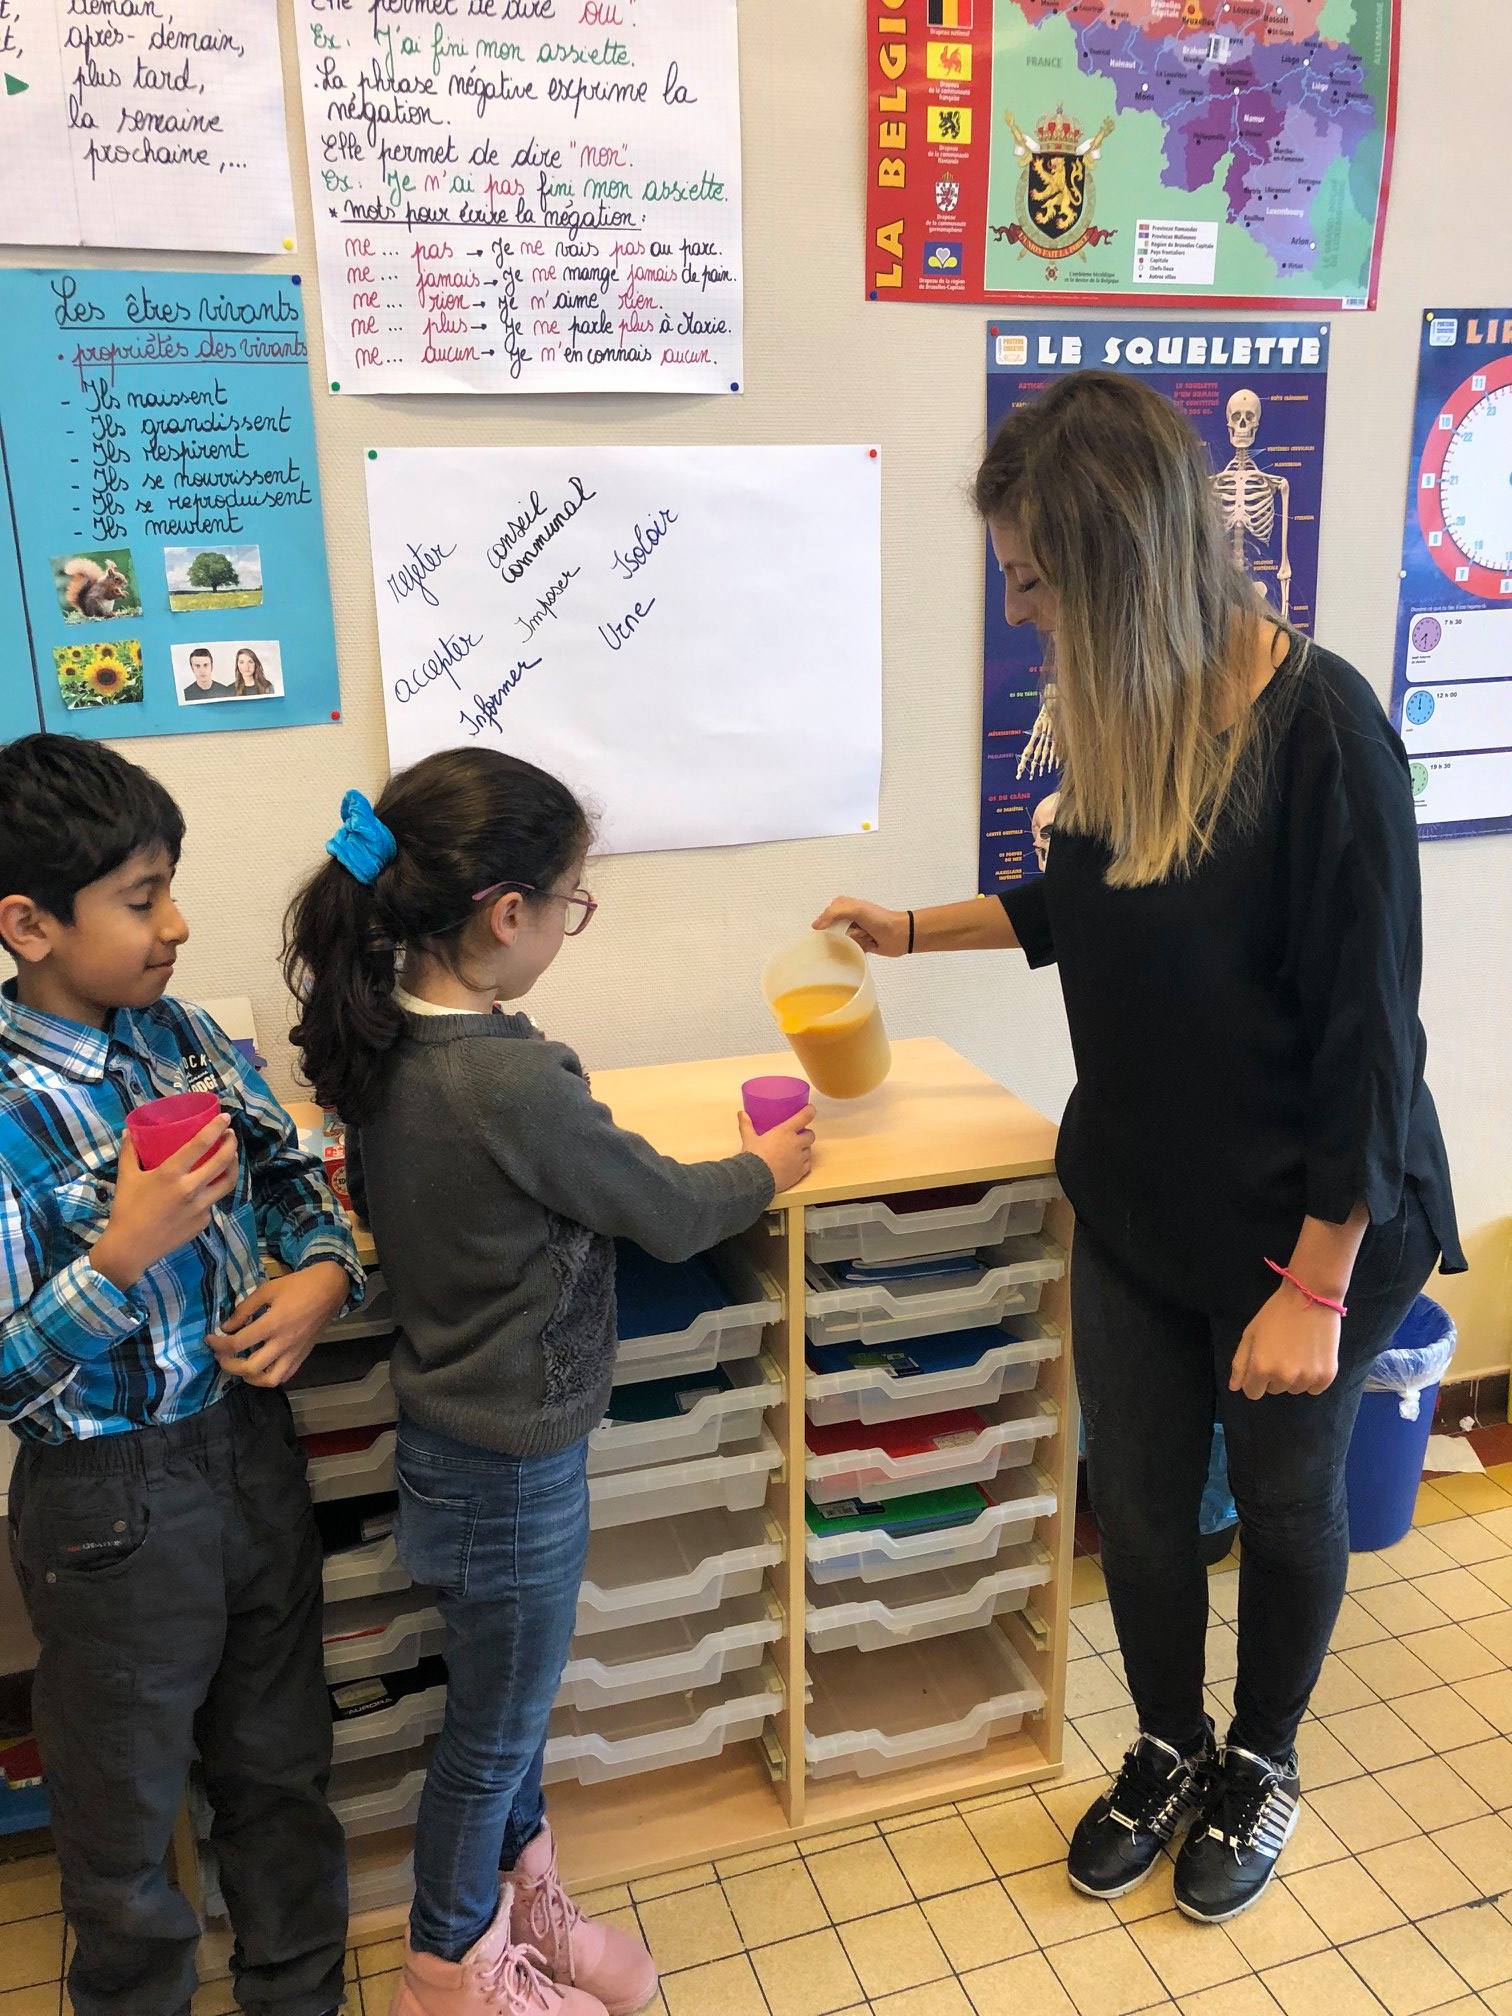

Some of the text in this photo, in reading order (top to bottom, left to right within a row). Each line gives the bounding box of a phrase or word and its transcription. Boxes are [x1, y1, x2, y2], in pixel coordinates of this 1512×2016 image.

[431, 22, 469, 76] fini
[476, 39, 526, 61] mon
[536, 38, 635, 67] assiette.
[1026, 56, 1063, 69] FRANCE
[73, 57, 205, 105] plus tard,
[358, 58, 438, 119] phrase
[449, 66, 538, 118] négative
[548, 77, 648, 119] exprime
[663, 61, 698, 105] la
[67, 95, 224, 133] la semaine
[328, 92, 451, 147] négation.
[321, 131, 365, 162] Elle
[378, 135, 459, 183] permet
[468, 138, 500, 166] de
[511, 136, 562, 168] dire
[388, 169, 416, 207] Je
[484, 174, 525, 212] pas
[537, 170, 575, 212] fini
[583, 178, 632, 200] mon
[642, 170, 728, 202] assiette.
[344, 195, 397, 220] mots
[406, 201, 451, 233] pour
[459, 200, 509, 225] écrire
[516, 197, 537, 224] la
[411, 241, 454, 274] pas
[492, 237, 515, 269] Je
[521, 239, 545, 256] ne
[555, 241, 600, 257] vais
[609, 240, 645, 269] pas
[650, 241, 674, 256] au
[679, 238, 722, 268] parc.
[876, 218, 905, 289] LA
[51, 275, 299, 326] Les êtres vivants
[416, 268, 480, 308] jamais
[502, 267, 525, 297] Je
[532, 266, 557, 282] ne
[563, 266, 619, 294] mange
[627, 264, 678, 297] jamais
[682, 262, 700, 284] de
[702, 265, 737, 292] pain.
[499, 295, 519, 323] Je
[618, 290, 664, 310] rien.
[422, 312, 468, 347] plus
[505, 317, 524, 350] Je
[533, 319, 560, 337] ne
[568, 309, 615, 348] parle
[618, 310, 655, 348] plus
[659, 313, 674, 335] à
[1038, 336, 1082, 364] LE
[1101, 336, 1321, 366] SQUELETTE
[72, 329, 308, 393] propriétés des vivants
[421, 346, 480, 364] aucun
[510, 346, 533, 379] Je
[587, 345, 652, 364] connais
[661, 347, 718, 366] aucun.
[83, 378, 228, 413] Ils naissent
[90, 406, 292, 446] Ils grandissent
[92, 433, 249, 480] Ils respirent
[92, 458, 301, 494] Ils se nourrissent
[91, 481, 312, 519] Ils se reproduisent
[91, 507, 244, 542] Ils meurent
[611, 508, 679, 580] Isoloir
[514, 566, 581, 644] Imposer
[599, 597, 656, 651] Urne
[458, 656, 543, 737] Informer
